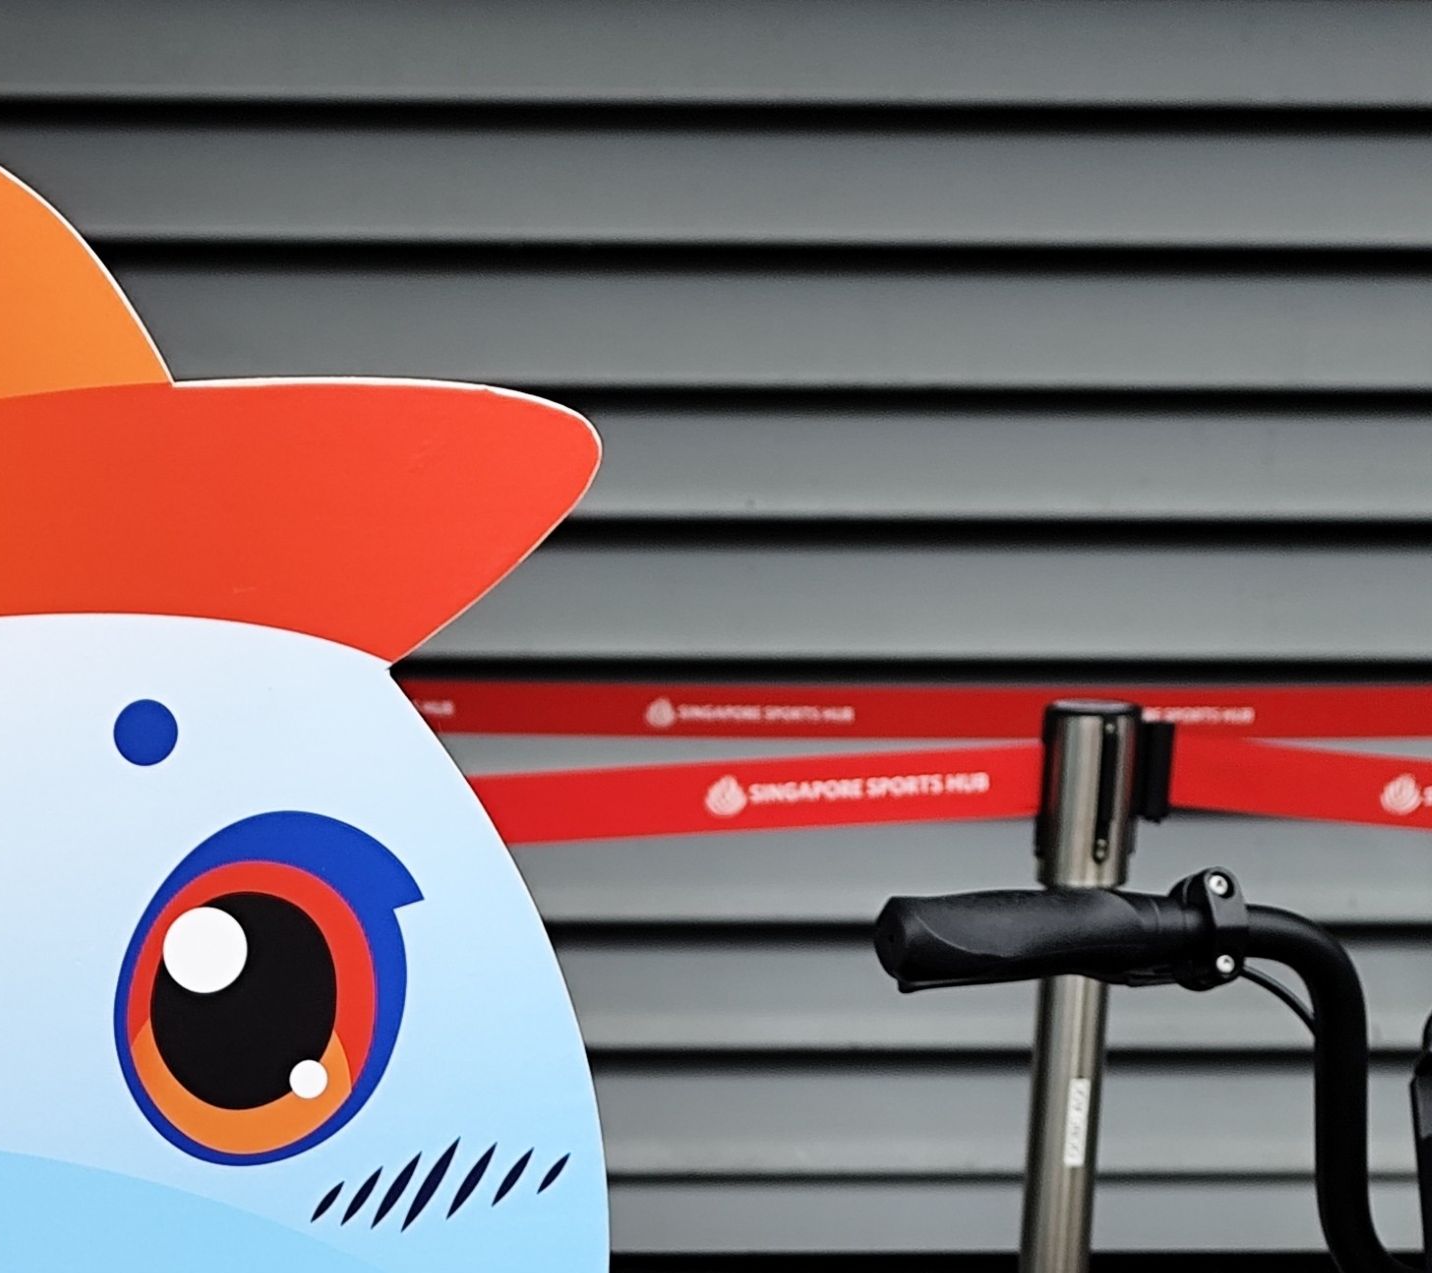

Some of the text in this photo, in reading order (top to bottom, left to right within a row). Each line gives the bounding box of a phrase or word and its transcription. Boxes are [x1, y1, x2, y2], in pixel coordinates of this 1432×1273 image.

[749, 771, 990, 804] SINGAPORE SPORTS HUB
